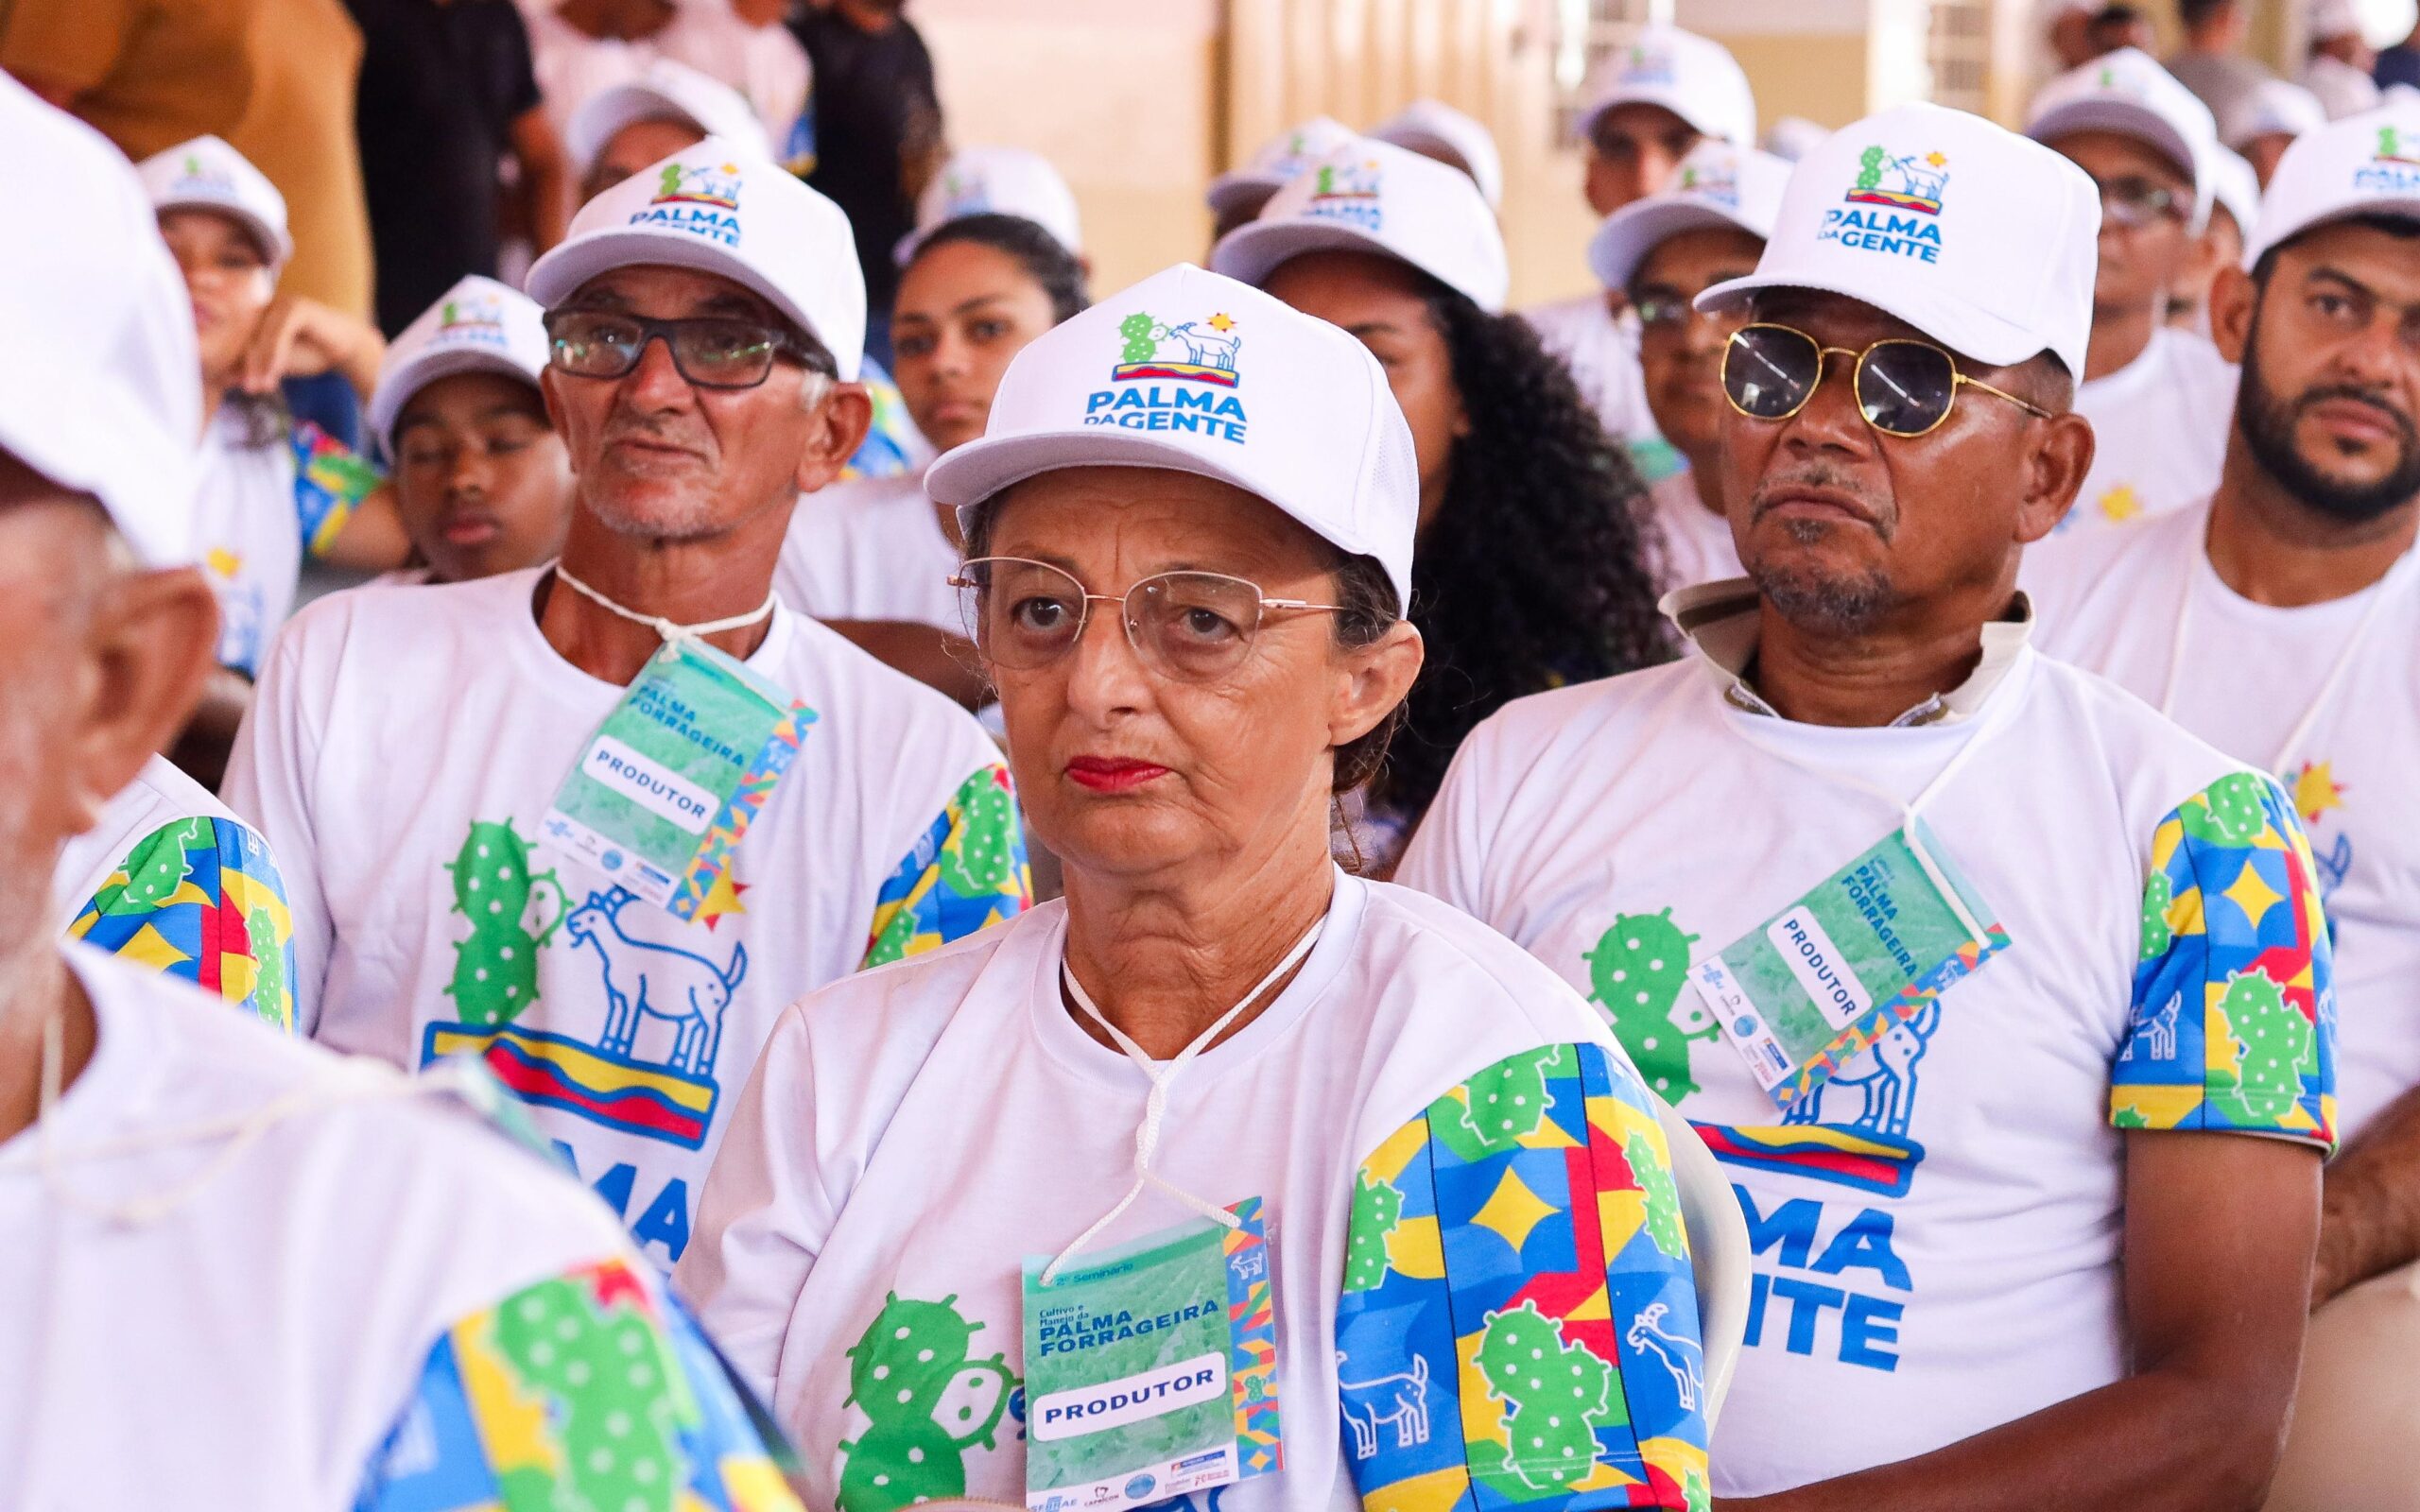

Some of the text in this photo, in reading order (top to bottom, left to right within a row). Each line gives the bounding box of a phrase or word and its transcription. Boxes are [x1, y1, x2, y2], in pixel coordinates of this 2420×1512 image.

[629, 208, 740, 234] PALMA
[1822, 209, 1943, 246] PALMA
[1841, 231, 1941, 265] GENTE
[1086, 387, 1248, 423] PALMA
[1118, 411, 1248, 446] GENTE
[596, 748, 707, 819] PRODUTOR
[1856, 865, 1898, 920] PALMA
[1841, 875, 1918, 978] FORRAGEIRA
[1783, 918, 1858, 1016] PRODUTOR
[1040, 1305, 1075, 1318] Cultivo
[1040, 1312, 1089, 1328] Manejo da
[1040, 1310, 1133, 1342] PALMA
[1041, 1299, 1219, 1357] FORRAGEIRA
[1045, 1368, 1215, 1424] PRODUTOR
